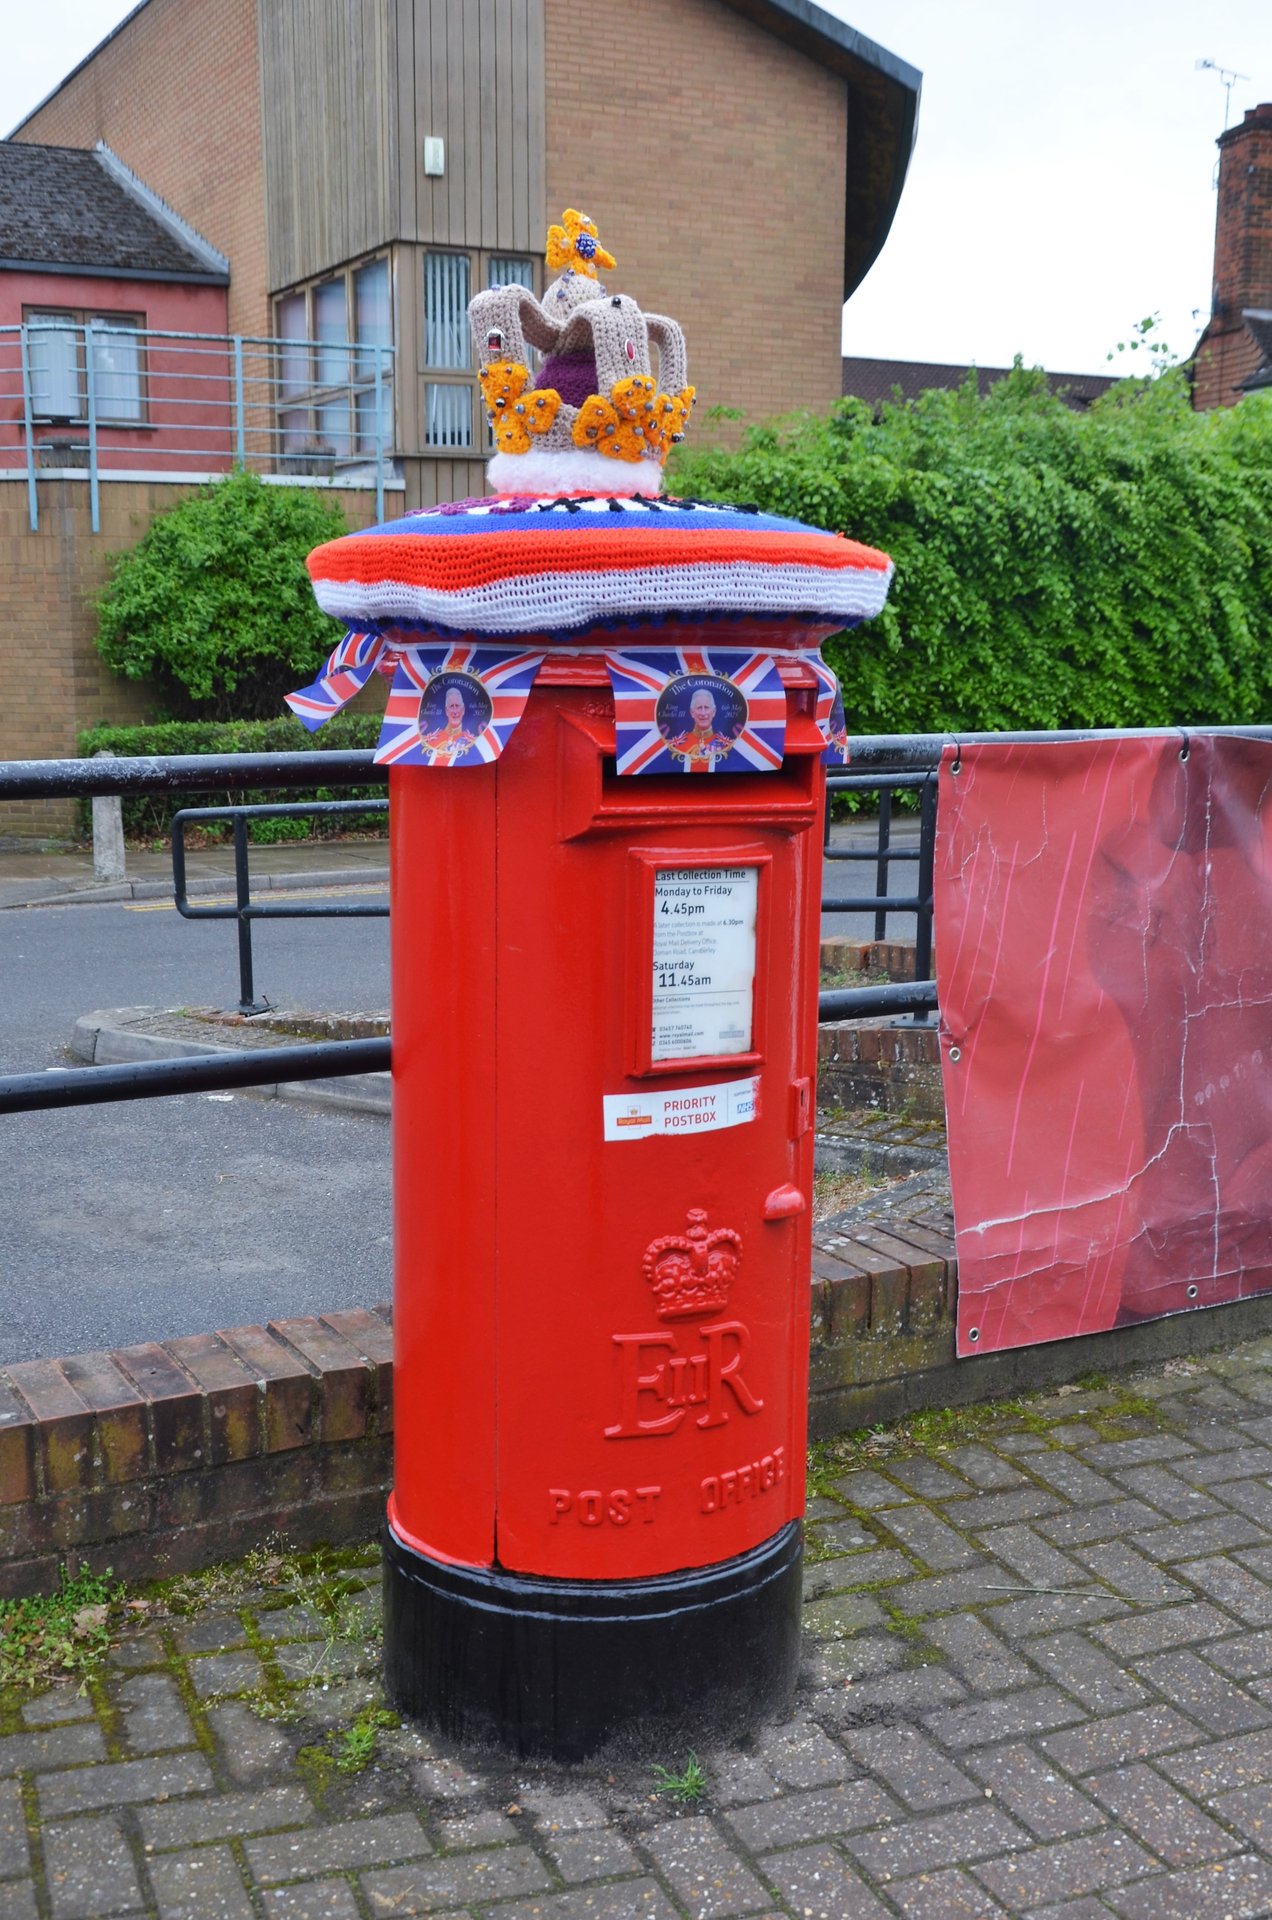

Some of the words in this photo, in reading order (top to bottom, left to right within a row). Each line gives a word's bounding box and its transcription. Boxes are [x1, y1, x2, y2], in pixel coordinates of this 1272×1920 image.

[442, 678, 480, 696] Coronation
[669, 683, 687, 697] The
[687, 679, 735, 698] Coronation
[656, 871, 675, 880] Last
[677, 869, 721, 880] Collection
[724, 869, 746, 879] Time
[655, 887, 691, 897] Monday
[693, 887, 702, 895] to
[704, 885, 732, 896] Friday
[661, 900, 705, 916] 4.45pm
[653, 960, 695, 971] Saturday
[659, 973, 711, 987] 11.45am
[664, 1095, 716, 1112] PRIORITY
[737, 1101, 754, 1113] NHS
[664, 1111, 716, 1128] POSTBOX
[549, 1486, 661, 1526] POST
